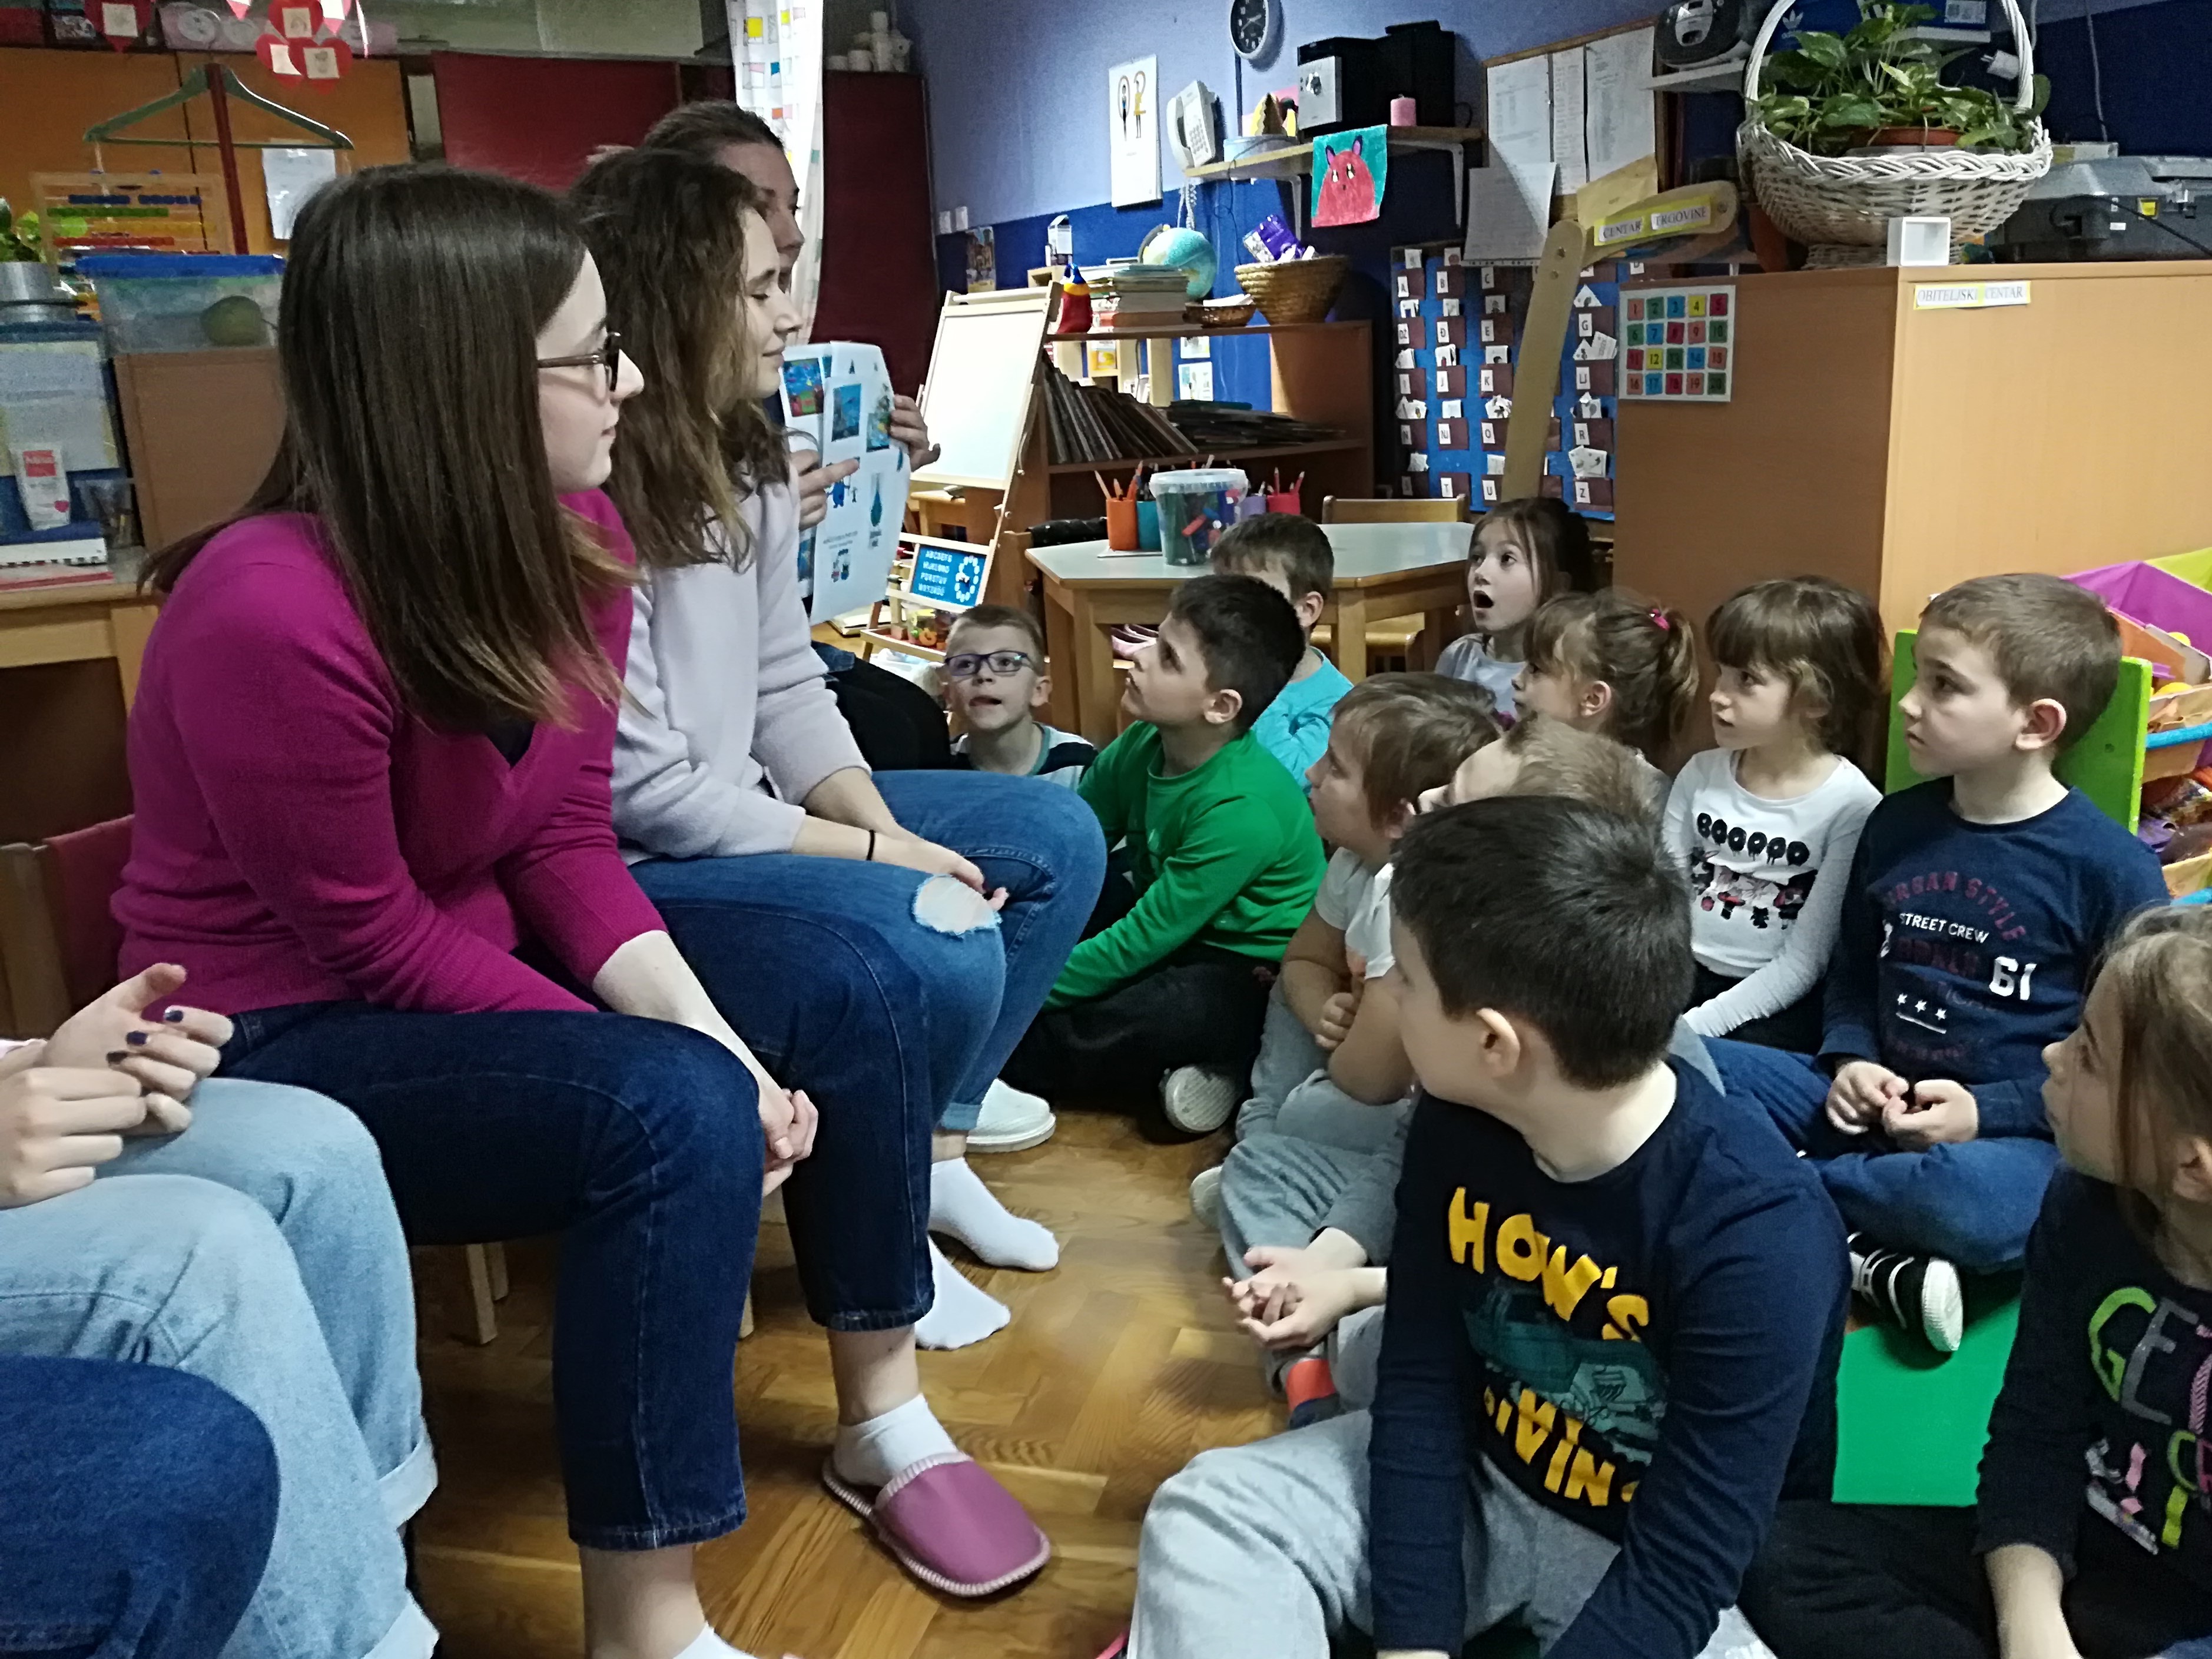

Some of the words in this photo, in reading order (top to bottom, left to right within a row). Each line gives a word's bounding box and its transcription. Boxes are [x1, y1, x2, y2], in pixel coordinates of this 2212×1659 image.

[1603, 220, 1643, 238] CENTAR
[1656, 205, 1707, 225] TRGOVINE
[1401, 283, 1407, 293] A
[1440, 278, 1445, 288] B
[1484, 273, 1490, 284] C
[1918, 288, 1978, 302] OBITELJSKI
[1985, 286, 2024, 300] CENTAR
[1633, 304, 1637, 315] 1
[1651, 303, 1659, 315] 2
[1693, 300, 1700, 312] 4
[1484, 326, 1491, 337] E
[1581, 320, 1588, 331] G
[1632, 329, 1638, 341] 6
[1651, 328, 1658, 340] 7
[1693, 326, 1700, 337] 9
[1713, 325, 1723, 337] 10
[1649, 354, 1660, 365] 12
[1712, 351, 1723, 364] 15
[1440, 378, 1444, 387] J
[1484, 376, 1490, 386] K
[1485, 429, 1491, 439] O
[1579, 430, 1586, 440] R
[1444, 484, 1448, 493] T
[1487, 486, 1493, 496] U
[1899, 913, 1947, 932] STREET
[1948, 923, 1989, 943] CREW
[1989, 956, 2037, 1001] 61
